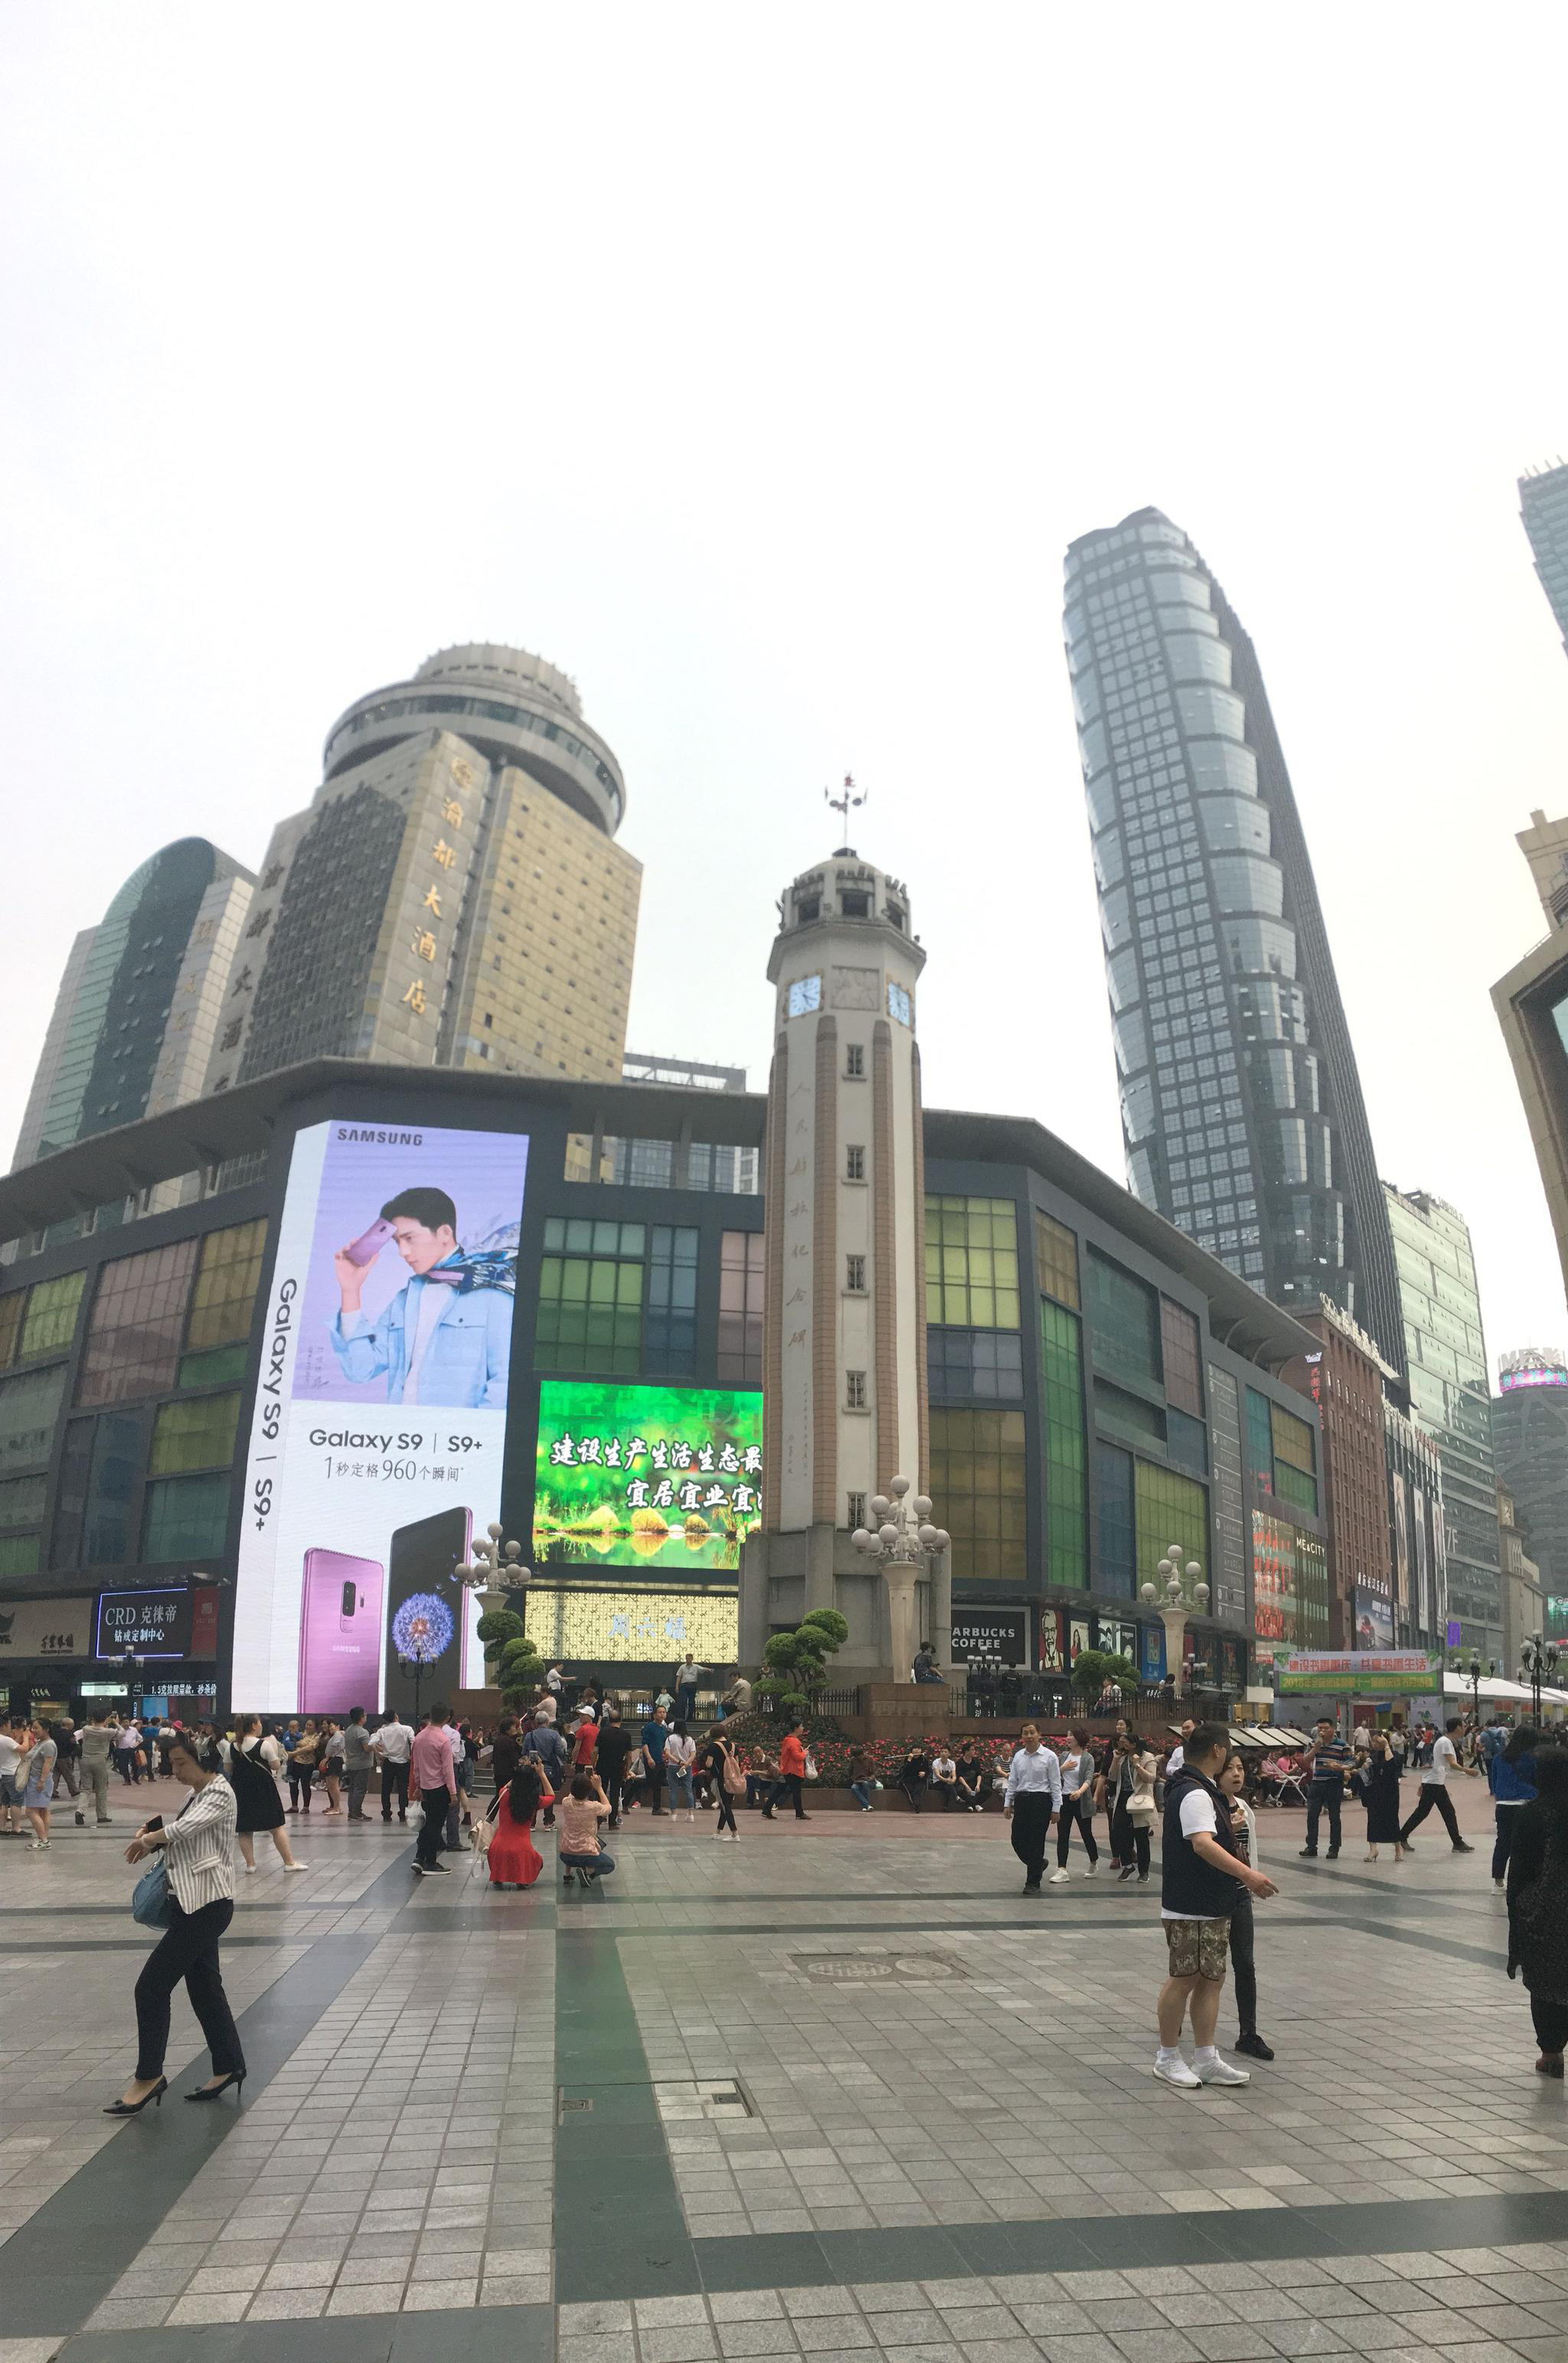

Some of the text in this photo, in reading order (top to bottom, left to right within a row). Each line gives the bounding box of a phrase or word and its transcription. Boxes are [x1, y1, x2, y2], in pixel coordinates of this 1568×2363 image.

[338, 1128, 423, 1146] SAMSUNG
[254, 1279, 297, 1531] Galaxy S9 S9+
[309, 1429, 482, 1453] Galaxy S9 S9+
[548, 1433, 763, 1474] 建设生产生活生态最
[626, 1479, 763, 1513] 宜居宜业宜
[105, 1608, 136, 1626] CRD
[115, 1628, 165, 1642] 钻戒定制中心
[952, 1627, 1015, 1638] ARBUCKS
